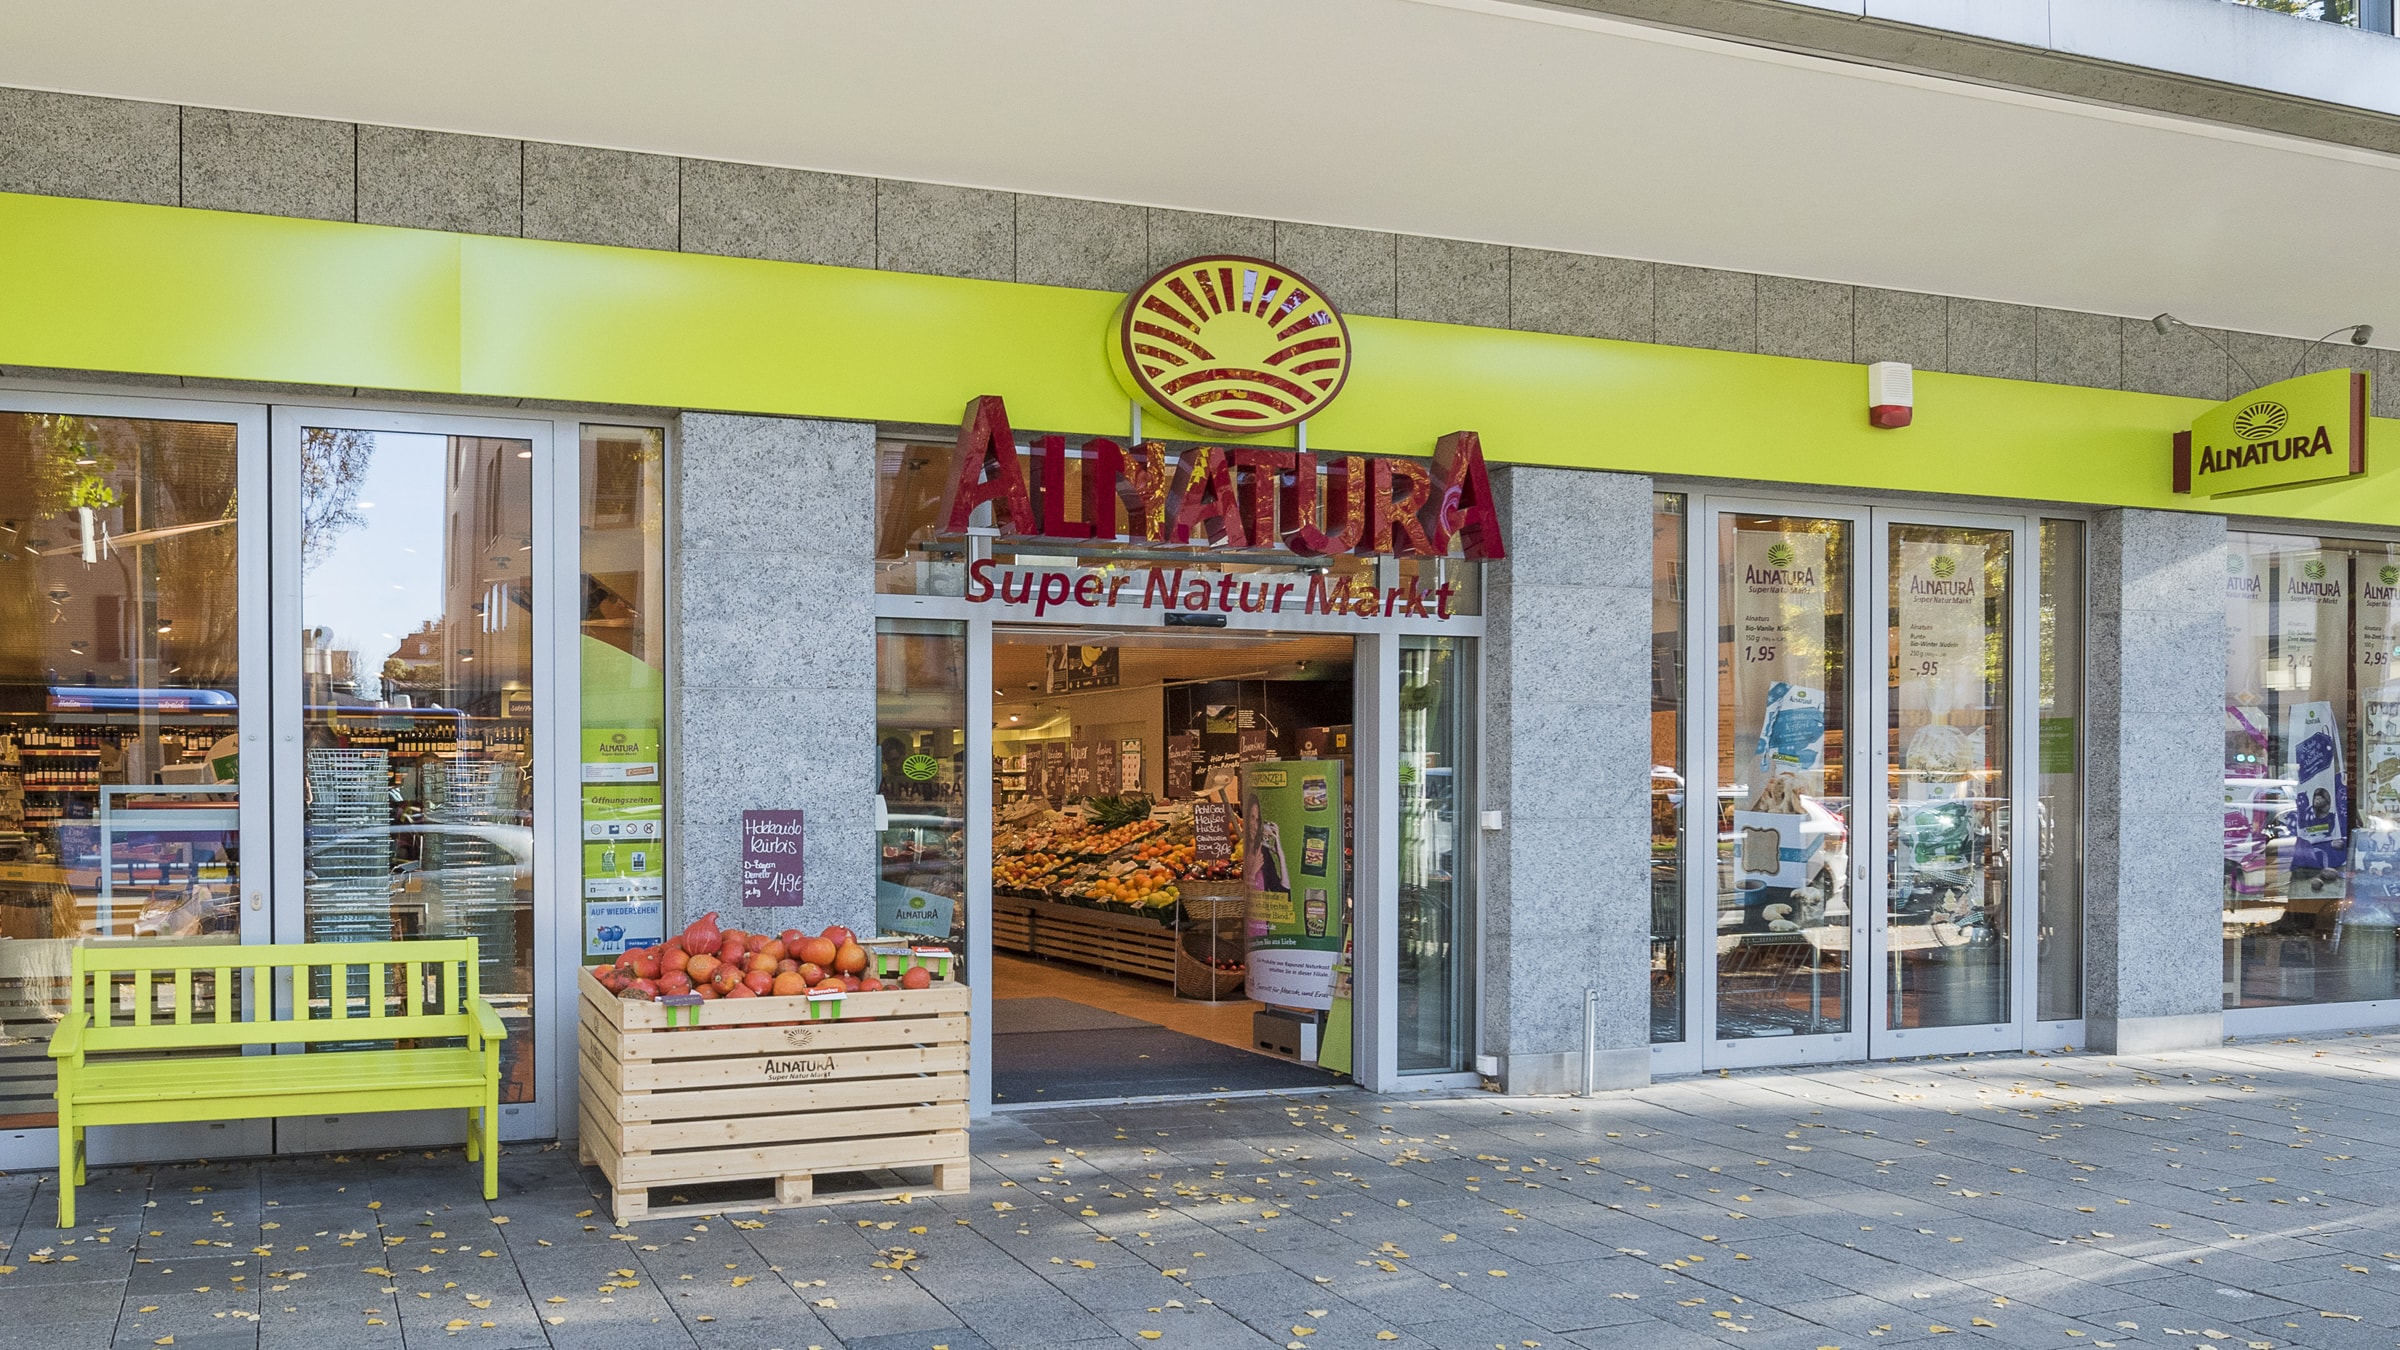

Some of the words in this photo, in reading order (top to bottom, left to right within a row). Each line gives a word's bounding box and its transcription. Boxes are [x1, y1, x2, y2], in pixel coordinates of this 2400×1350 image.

[2199, 426, 2333, 475] ALNATURA
[937, 395, 1505, 562] ALNATURA
[1745, 564, 1815, 586] ALNATURA
[2226, 575, 2261, 592] ATURA
[965, 559, 1130, 617] Super
[1142, 567, 1294, 613] Natur
[1304, 574, 1454, 619] Markt
[1769, 586, 1790, 594] Nat
[1910, 575, 1975, 596] ALNATURA
[2287, 577, 2341, 597] ALNATURA
[2364, 582, 2400, 600] ALNATU
[1745, 646, 1776, 663] 1,95
[2364, 652, 2388, 666] 2,95
[600, 743, 639, 752] ALNATURA
[591, 796, 654, 806] Öffnungszeiten
[745, 819, 802, 835] Hokkaido
[751, 836, 797, 855] Kürbis
[768, 872, 802, 896] 1,49€
[895, 908, 938, 919] ALNATURA
[764, 1056, 835, 1074] ALNATURA
